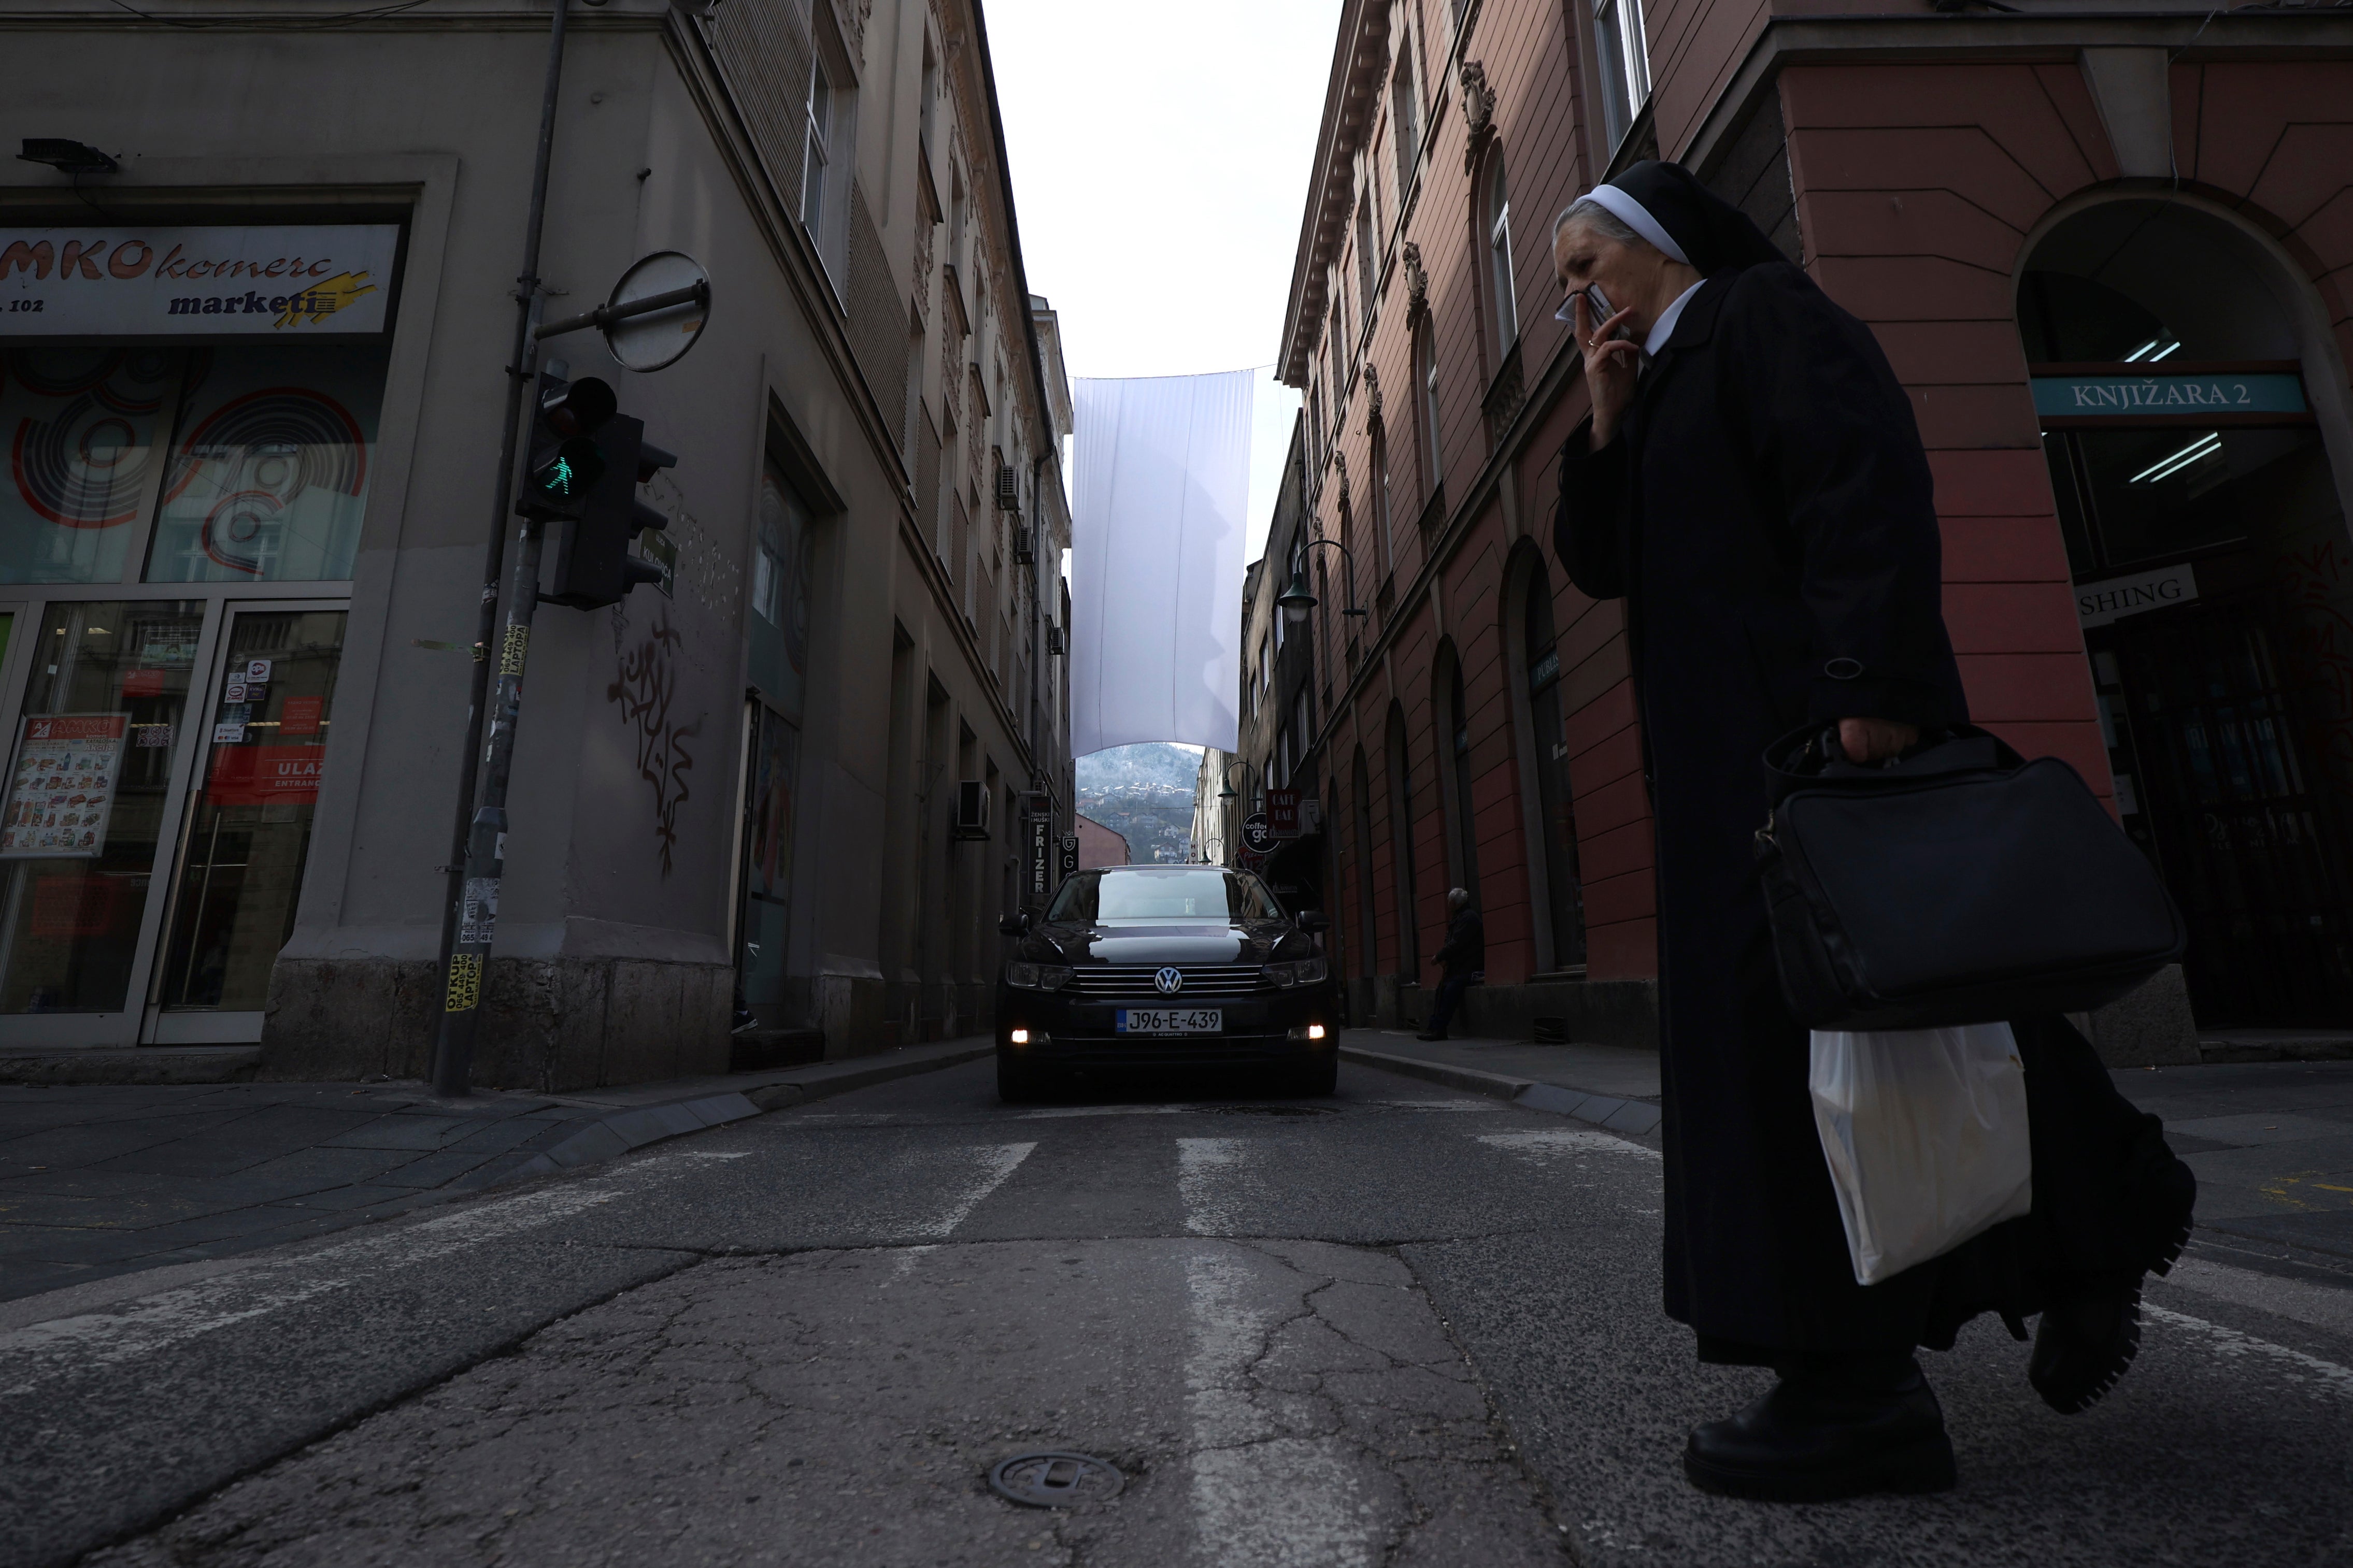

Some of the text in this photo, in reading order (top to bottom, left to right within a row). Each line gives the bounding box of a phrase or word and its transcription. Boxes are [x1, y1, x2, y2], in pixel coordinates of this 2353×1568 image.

[155, 243, 332, 279] komerc
[9, 300, 44, 312] 102
[2072, 379, 2250, 409] KNJIŽARA 2
[2079, 579, 2181, 615] SHING
[510, 627, 525, 673] LAPTOPA
[1273, 794, 1295, 805] CAFE
[1275, 810, 1293, 821] BAR
[1035, 825, 1044, 893] FRIZER
[447, 955, 460, 1009] OTKUP
[1130, 1012, 1218, 1029] J96-E-439
